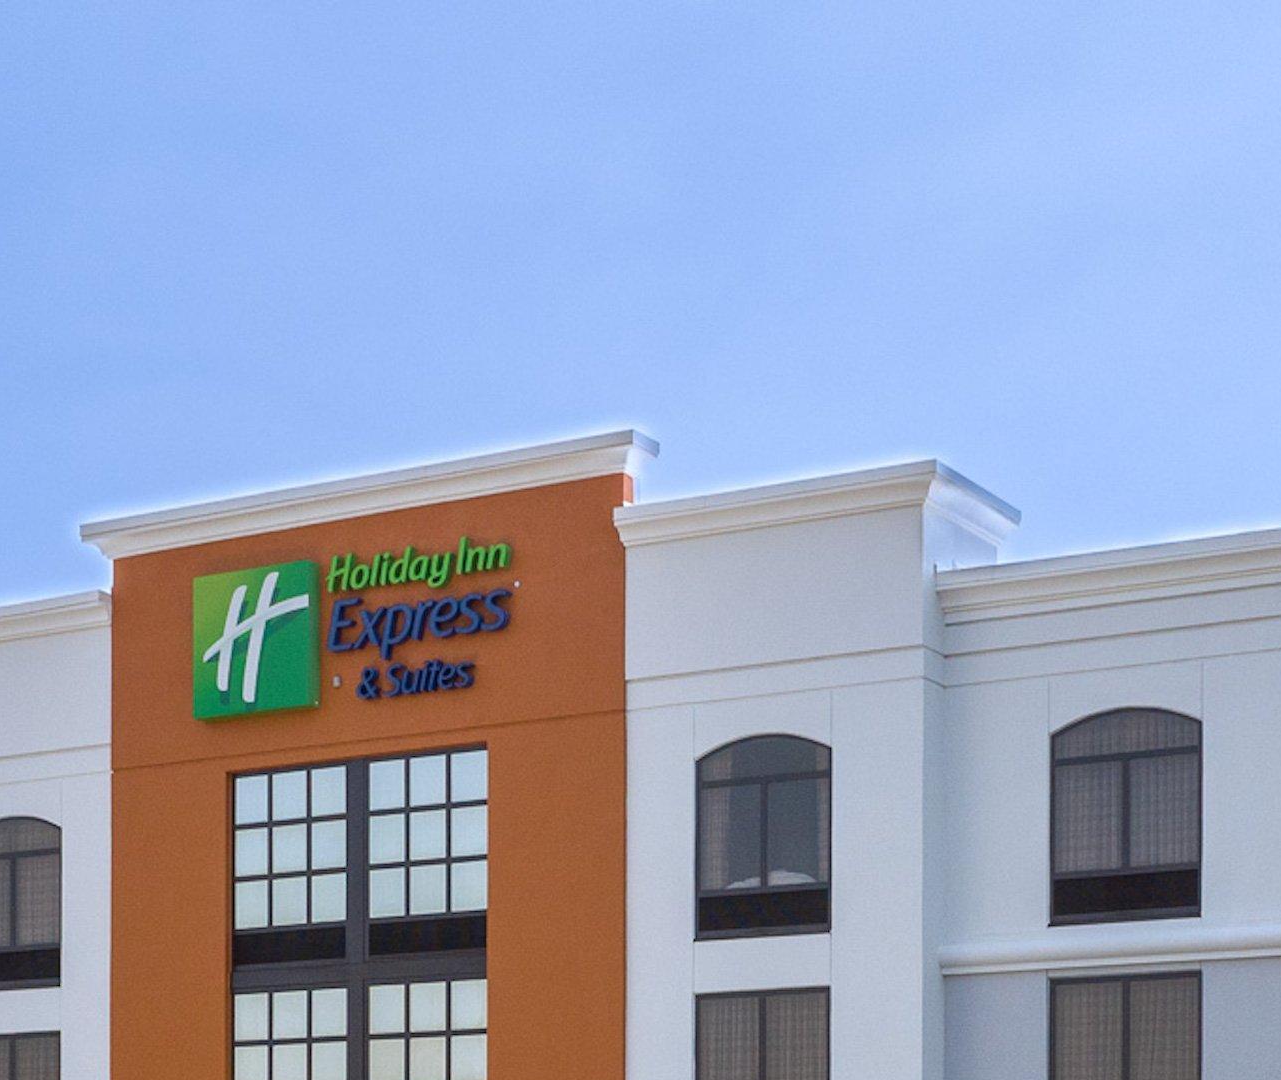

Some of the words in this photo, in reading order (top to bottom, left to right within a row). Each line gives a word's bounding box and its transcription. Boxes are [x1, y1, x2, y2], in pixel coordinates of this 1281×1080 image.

[326, 544, 452, 593] Holiday
[455, 535, 510, 575] Inn
[202, 571, 309, 703] H
[327, 588, 512, 660] Express
[355, 667, 380, 699] &
[383, 658, 474, 697] Suites
